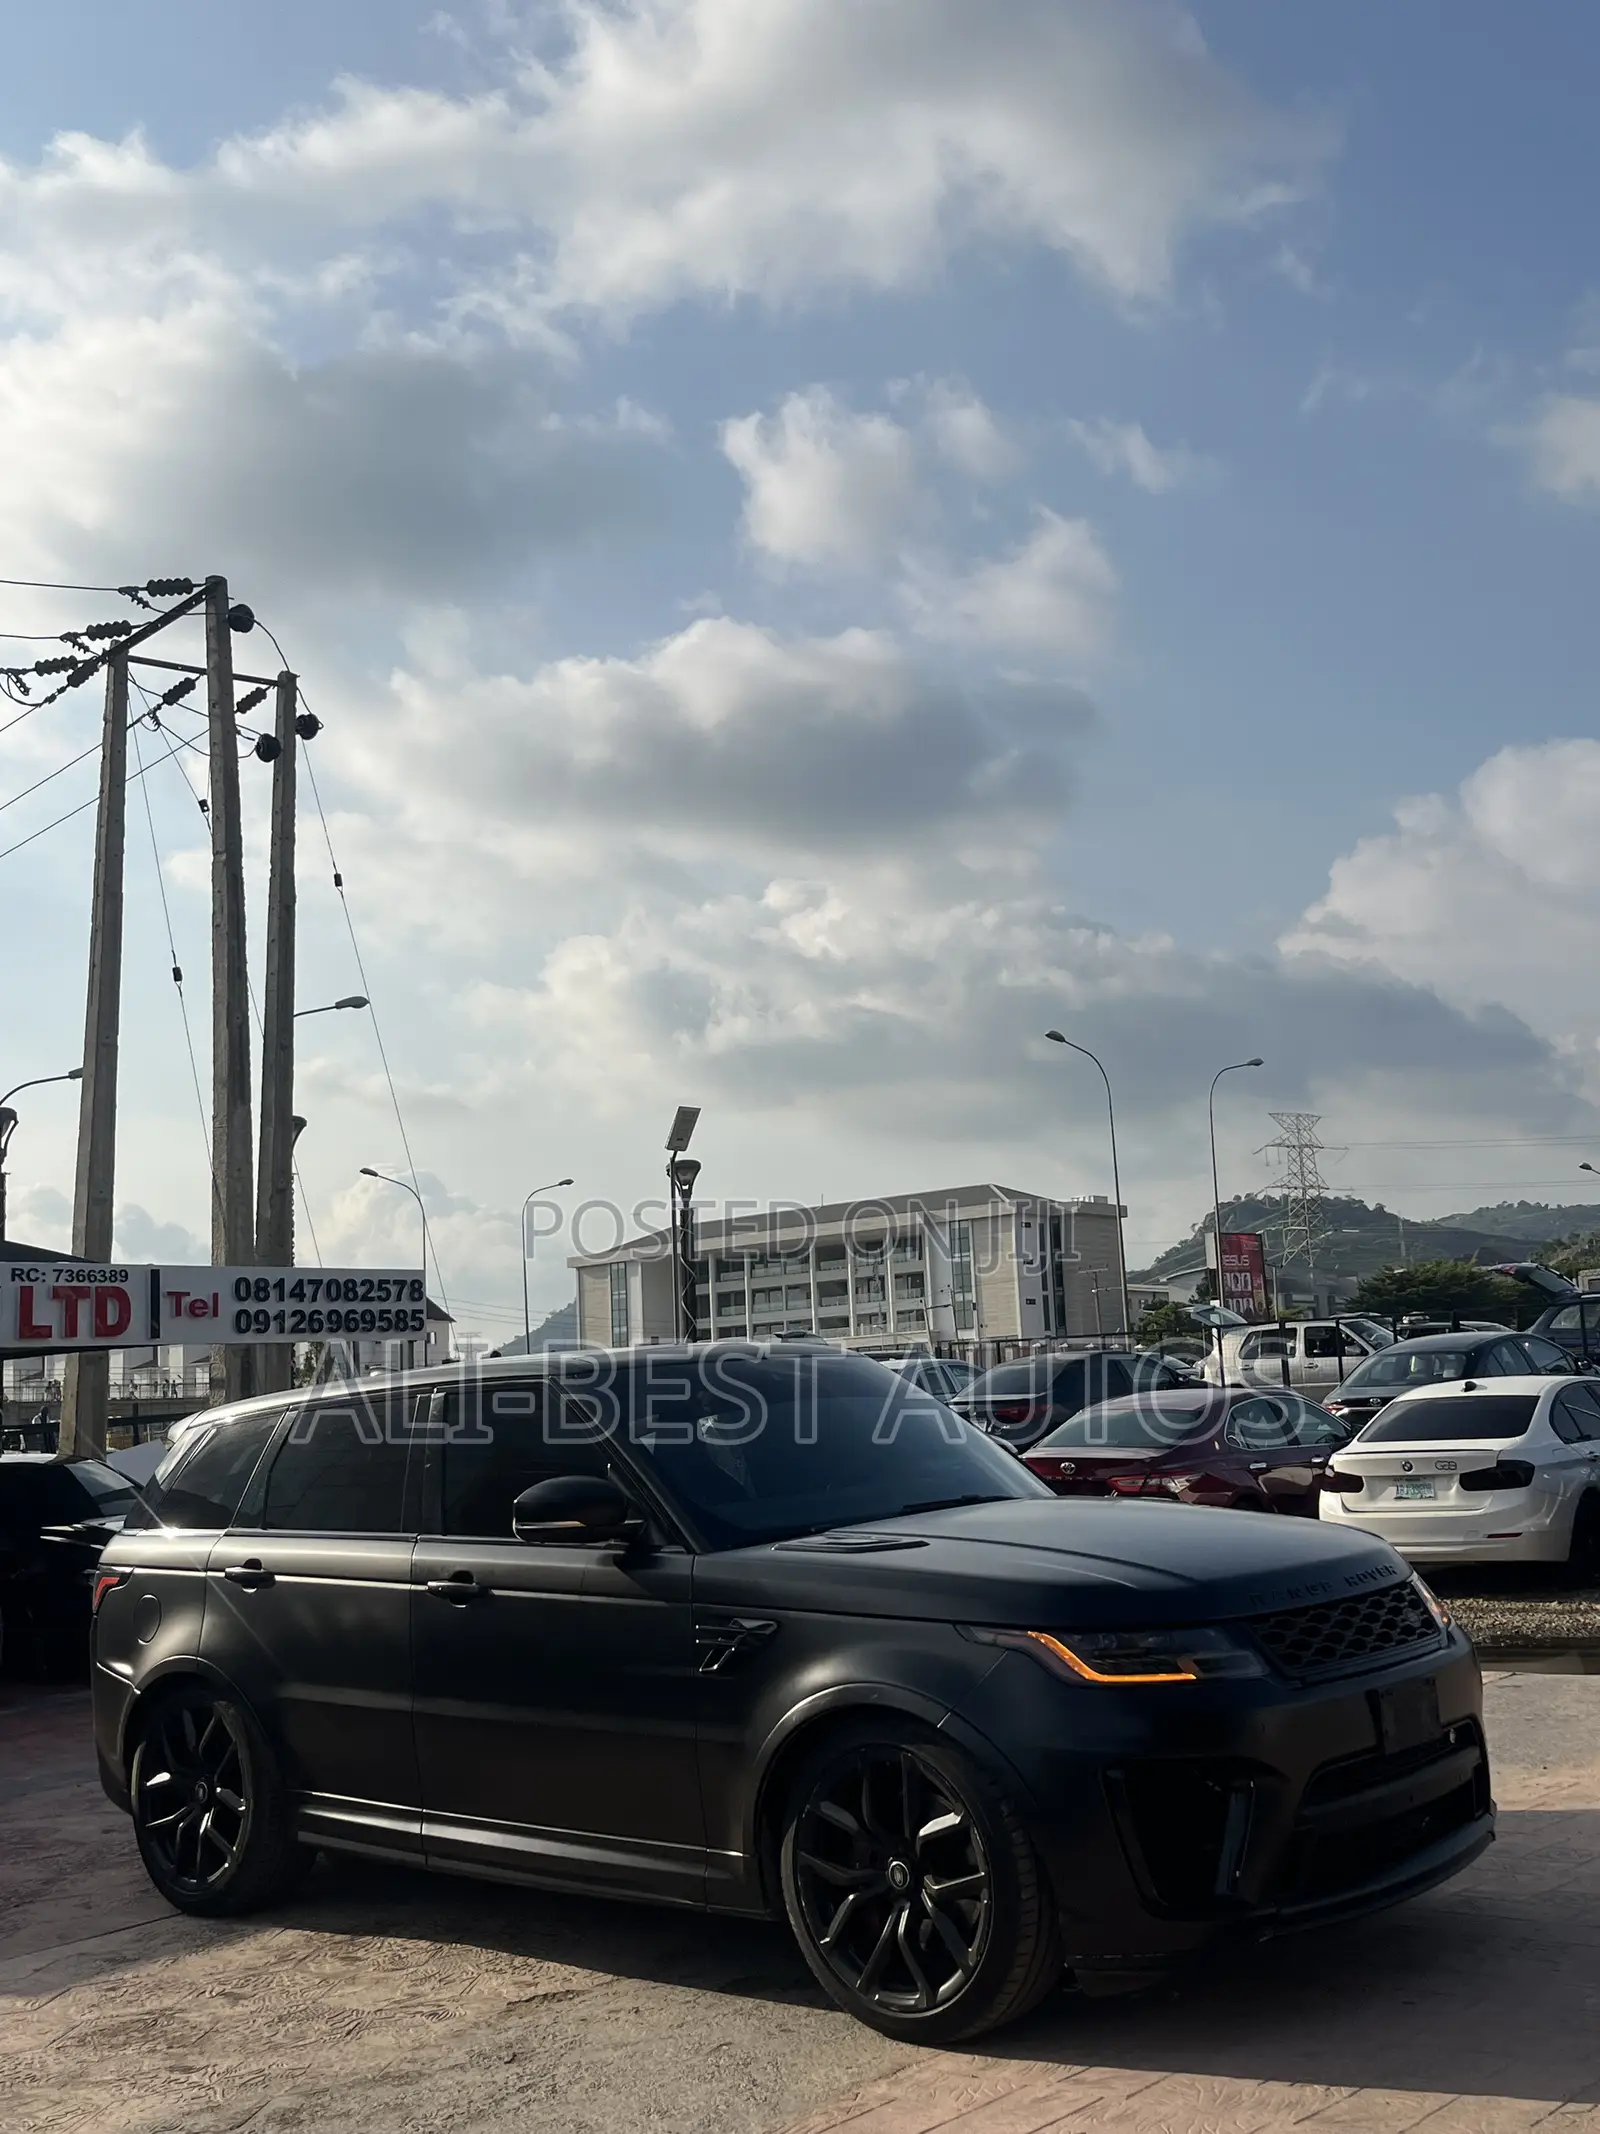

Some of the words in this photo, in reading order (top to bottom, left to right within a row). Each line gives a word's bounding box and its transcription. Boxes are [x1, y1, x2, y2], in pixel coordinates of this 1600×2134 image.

[10, 1267, 46, 1283] RC:
[52, 1269, 129, 1283] 7366389
[234, 1276, 424, 1303] 08147082578
[17, 1285, 132, 1339] LTD
[166, 1291, 220, 1318] Tel
[234, 1308, 425, 1334] 09126969585
[1342, 1562, 1399, 1587] ROVER
